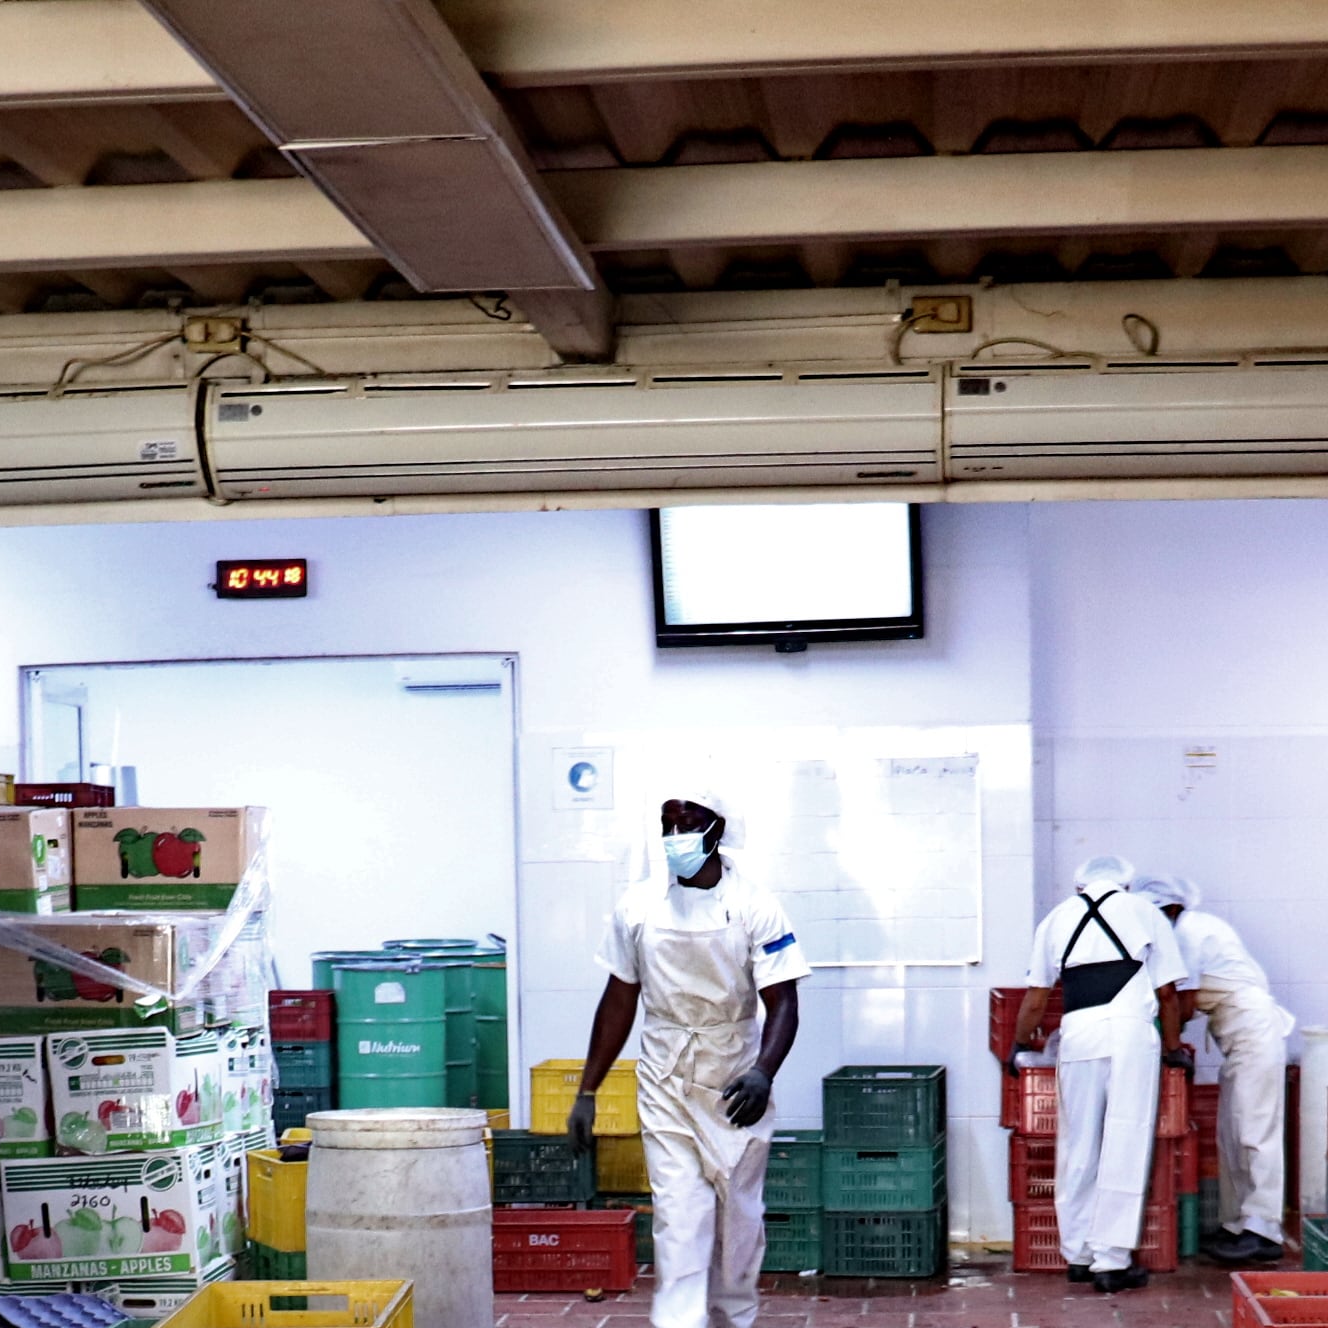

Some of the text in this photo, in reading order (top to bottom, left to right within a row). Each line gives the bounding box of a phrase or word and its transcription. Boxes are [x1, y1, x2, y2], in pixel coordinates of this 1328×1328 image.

[253, 569, 280, 586] 44
[529, 1233, 560, 1247] BAC
[31, 1262, 108, 1280] MANZANAS
[120, 1256, 172, 1276] APPLES
